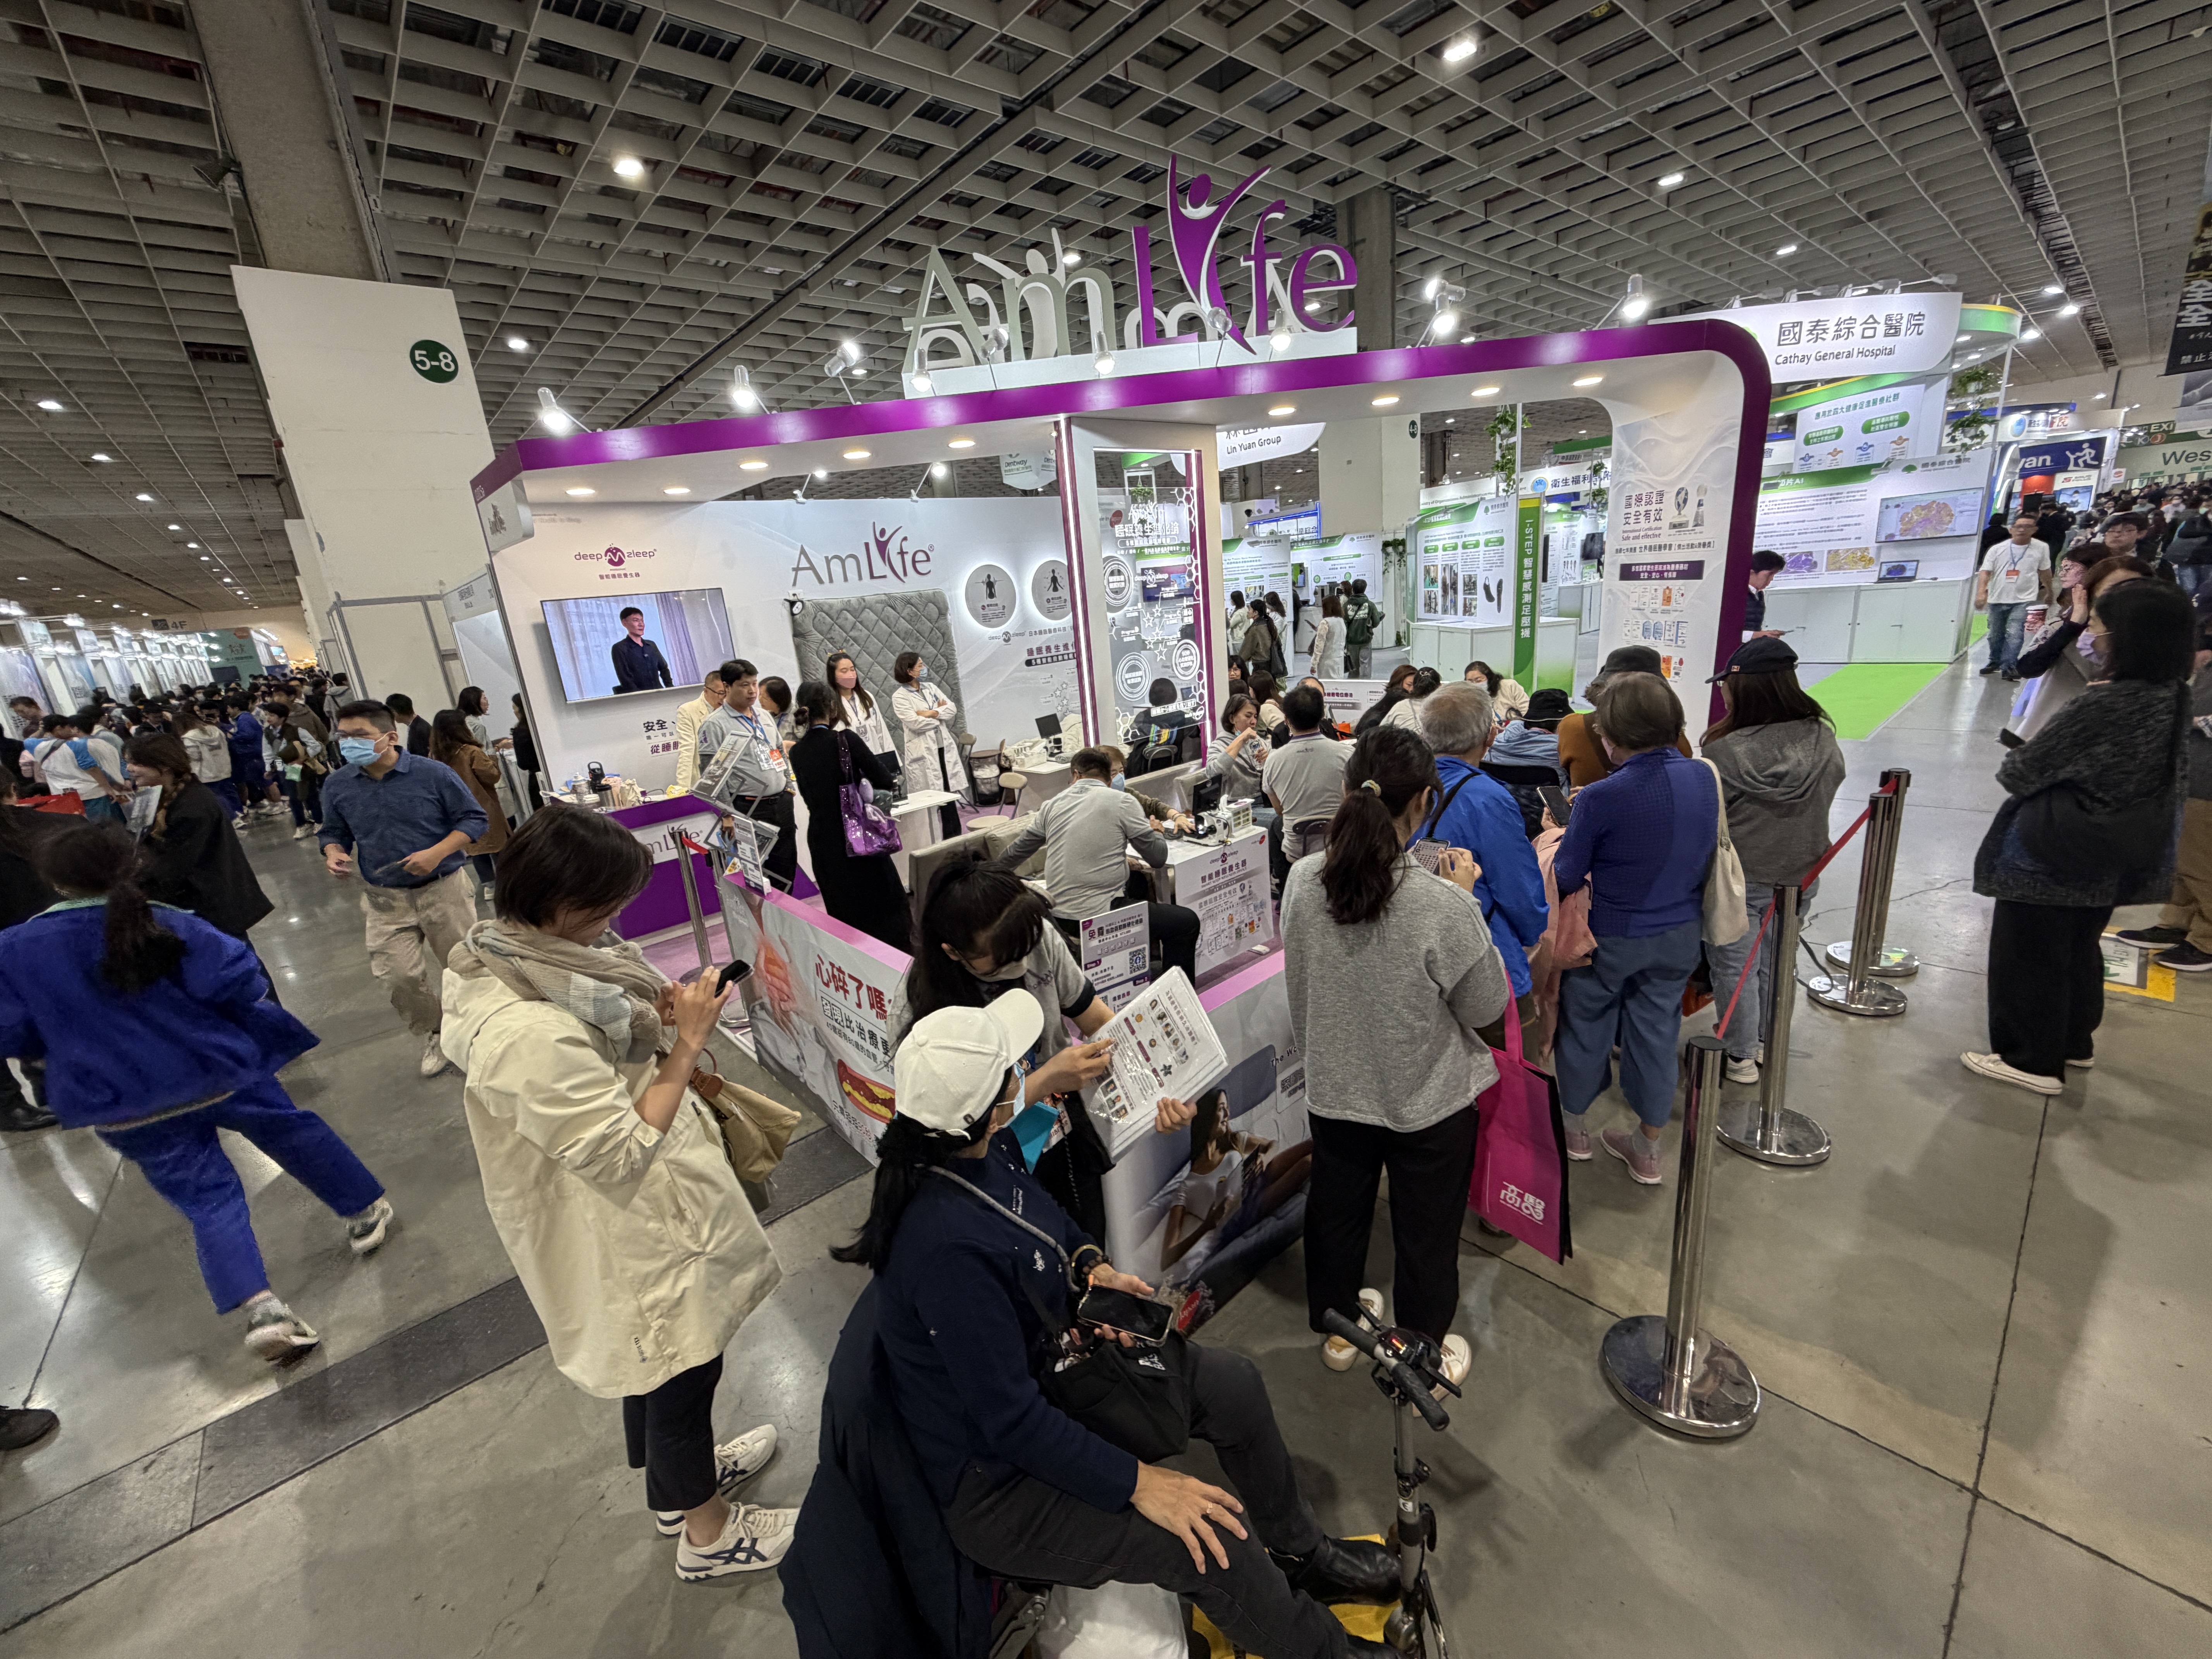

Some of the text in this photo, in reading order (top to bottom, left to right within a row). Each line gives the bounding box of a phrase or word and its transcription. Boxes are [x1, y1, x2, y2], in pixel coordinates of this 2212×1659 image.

[1777, 311, 1925, 347] 國泰綜合醫院
[414, 350, 455, 372] 5-8
[1775, 345, 1896, 365] Cathay General Hospital
[2180, 352, 2212, 365] 禁止
[2150, 422, 2176, 433] EXI
[1227, 435, 1281, 454] Lin Yuan Group
[1005, 459, 1027, 468] Dentway
[1624, 490, 1665, 509] 國際認證
[1623, 507, 1663, 526] 安全有效
[1525, 519, 1534, 555] I-STEP
[574, 550, 655, 562] deep zleep
[792, 521, 934, 587] AmLife
[815, 953, 892, 1020] 心碎了嗎
[1271, 1055, 1284, 1067] The
